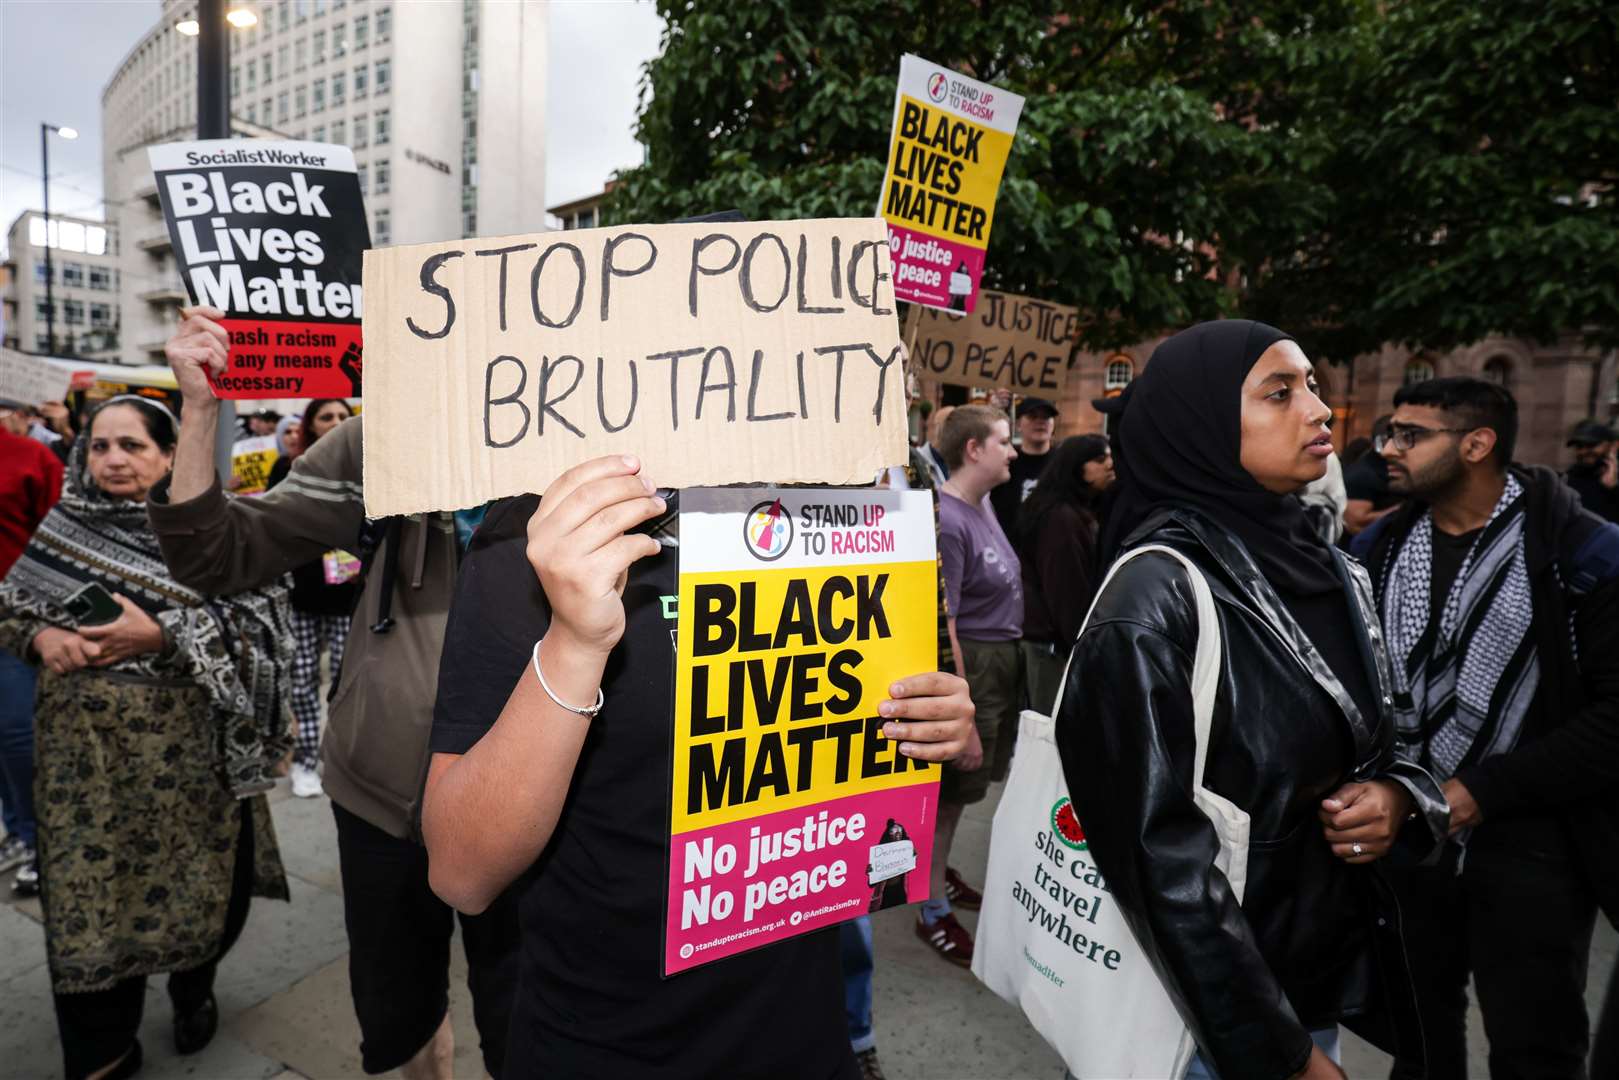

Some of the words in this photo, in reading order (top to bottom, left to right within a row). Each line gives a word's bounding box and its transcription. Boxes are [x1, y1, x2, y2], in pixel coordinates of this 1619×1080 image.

[949, 95, 960, 109] TO
[960, 100, 994, 122] RACISM
[951, 80, 980, 101] STAND
[980, 91, 994, 105] UP
[900, 101, 984, 164] BLACK
[165, 171, 332, 218] Black
[894, 141, 965, 195] LIVES
[886, 180, 987, 241] MATTER
[176, 217, 325, 265] Lives
[900, 233, 953, 266] justice
[406, 231, 658, 340] STOP
[689, 232, 893, 318] POLICE
[897, 262, 942, 287] peace
[276, 329, 336, 347] racism
[981, 293, 1078, 346] JUSTICE
[234, 354, 267, 371] any
[274, 354, 333, 369] means
[913, 338, 954, 373] NO
[962, 342, 1061, 389] PEACE
[483, 343, 902, 449] BRUTALITY
[800, 504, 859, 529] STAND
[863, 504, 885, 528] UP
[801, 532, 826, 556] TO
[832, 530, 895, 556] RACISM
[692, 573, 892, 658] BLACK
[690, 649, 864, 737] LIVES
[683, 837, 737, 884] No
[743, 810, 866, 879] justice
[1035, 830, 1064, 868] she
[681, 884, 735, 931] No
[743, 859, 848, 923] peace
[1034, 862, 1102, 925] travel
[695, 918, 786, 953] standuptoracism.org.uk
[803, 897, 861, 921] @AntiRacismDay
[1012, 880, 1122, 971] anywhere
